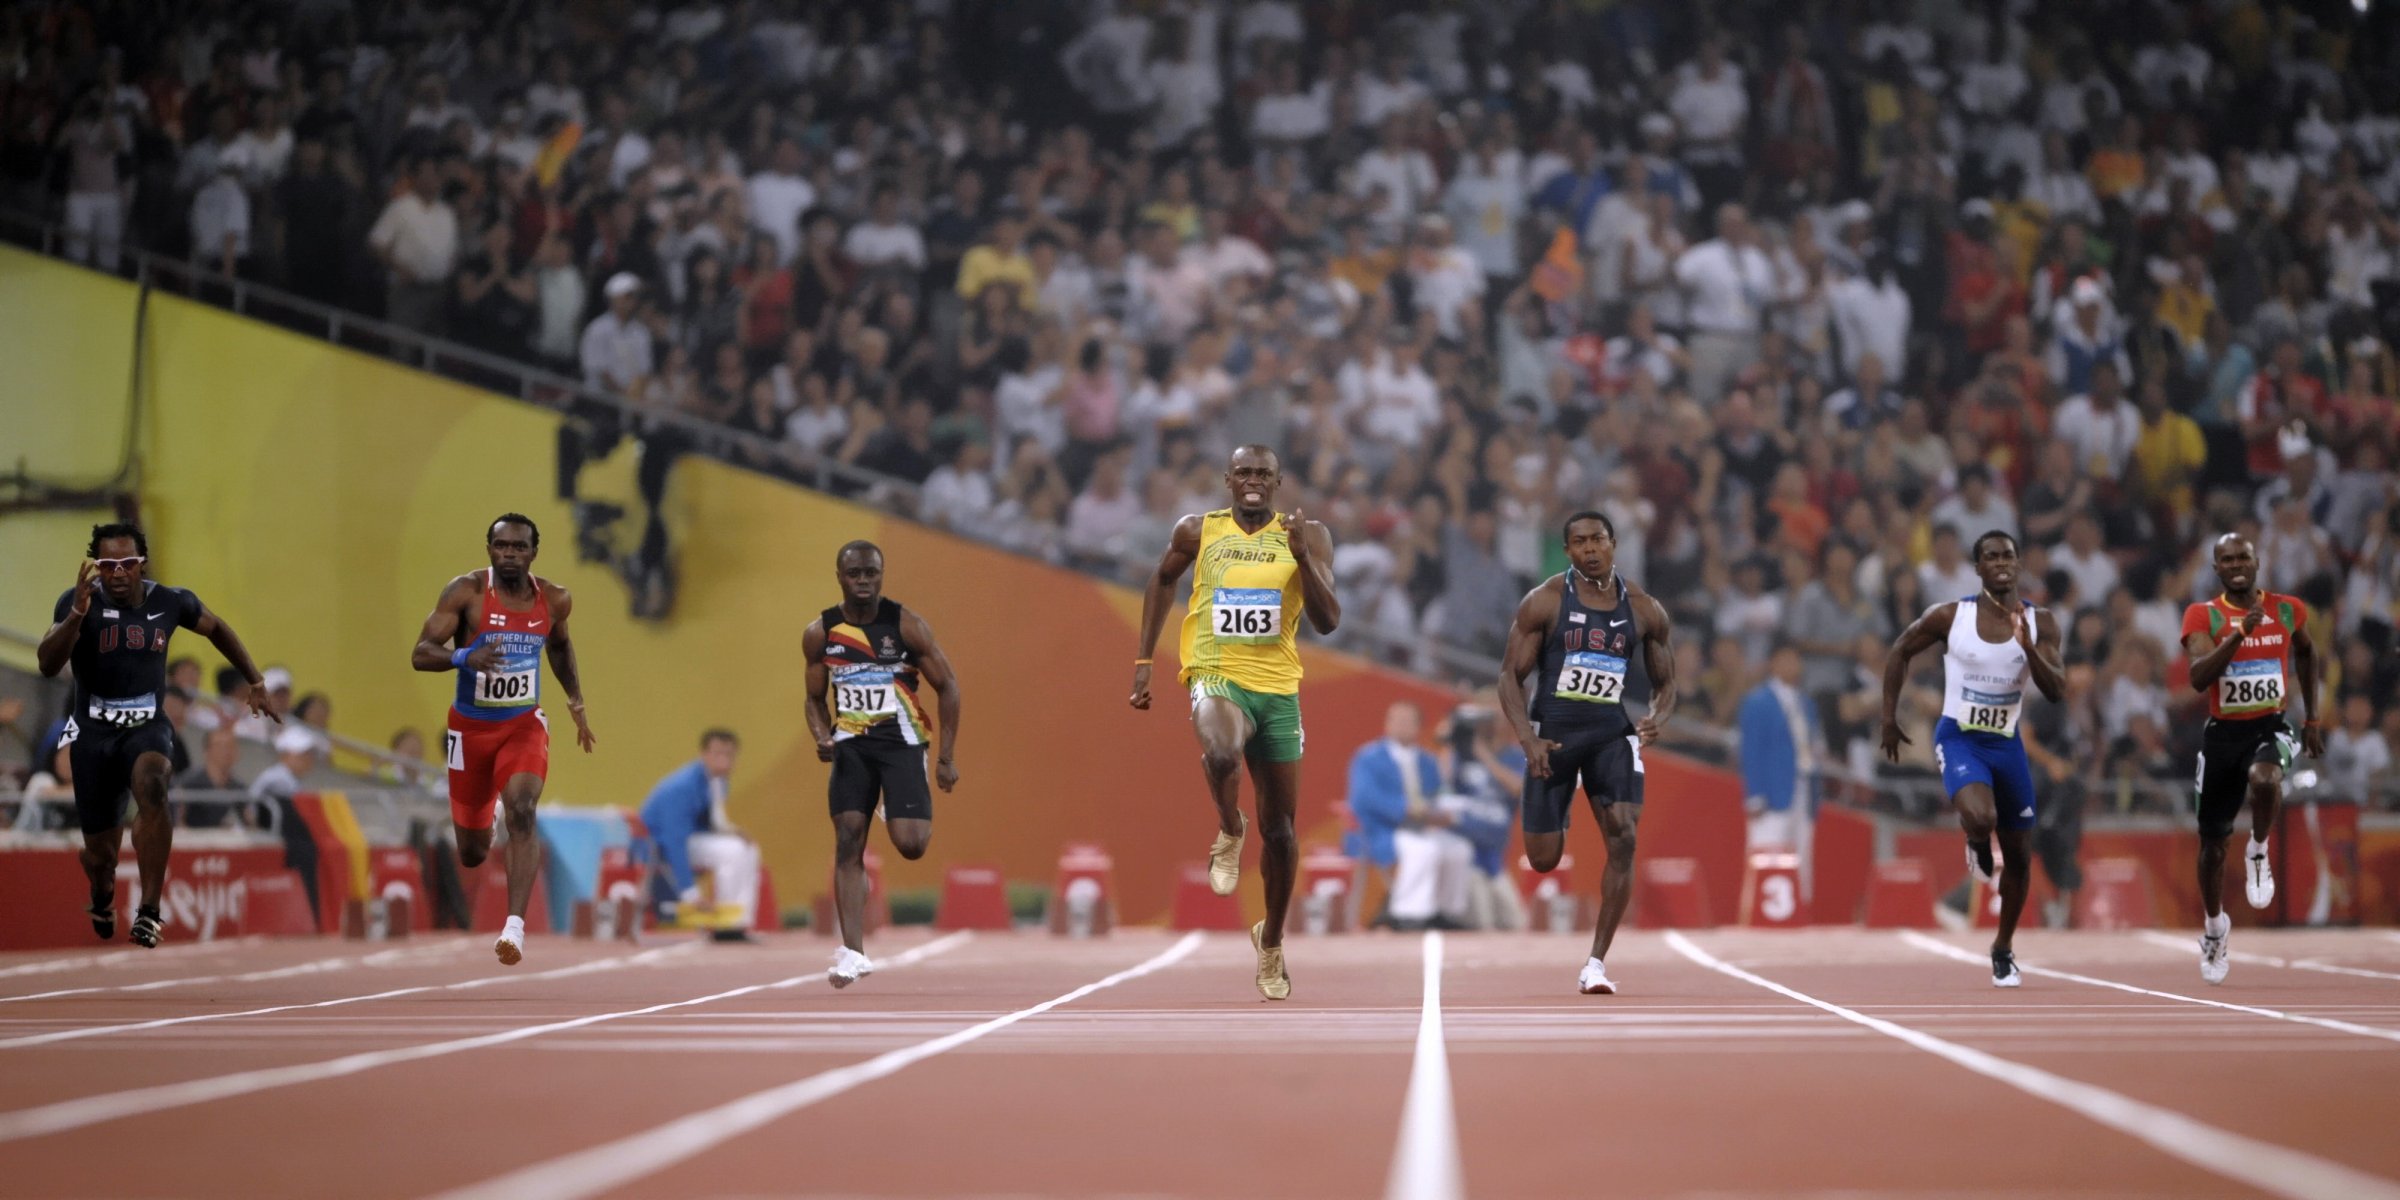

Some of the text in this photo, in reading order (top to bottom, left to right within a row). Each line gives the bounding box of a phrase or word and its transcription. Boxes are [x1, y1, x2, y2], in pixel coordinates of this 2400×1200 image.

[1214, 545, 1276, 562] jamaica
[1220, 608, 1272, 634] 2163
[1565, 628, 1626, 654] USA
[484, 675, 529, 699] 1003
[1567, 669, 1618, 698] 3152
[2225, 679, 2279, 703] 2868
[842, 687, 886, 711] 3317
[1969, 706, 2008, 729] 1813
[1760, 874, 1796, 922] 3
